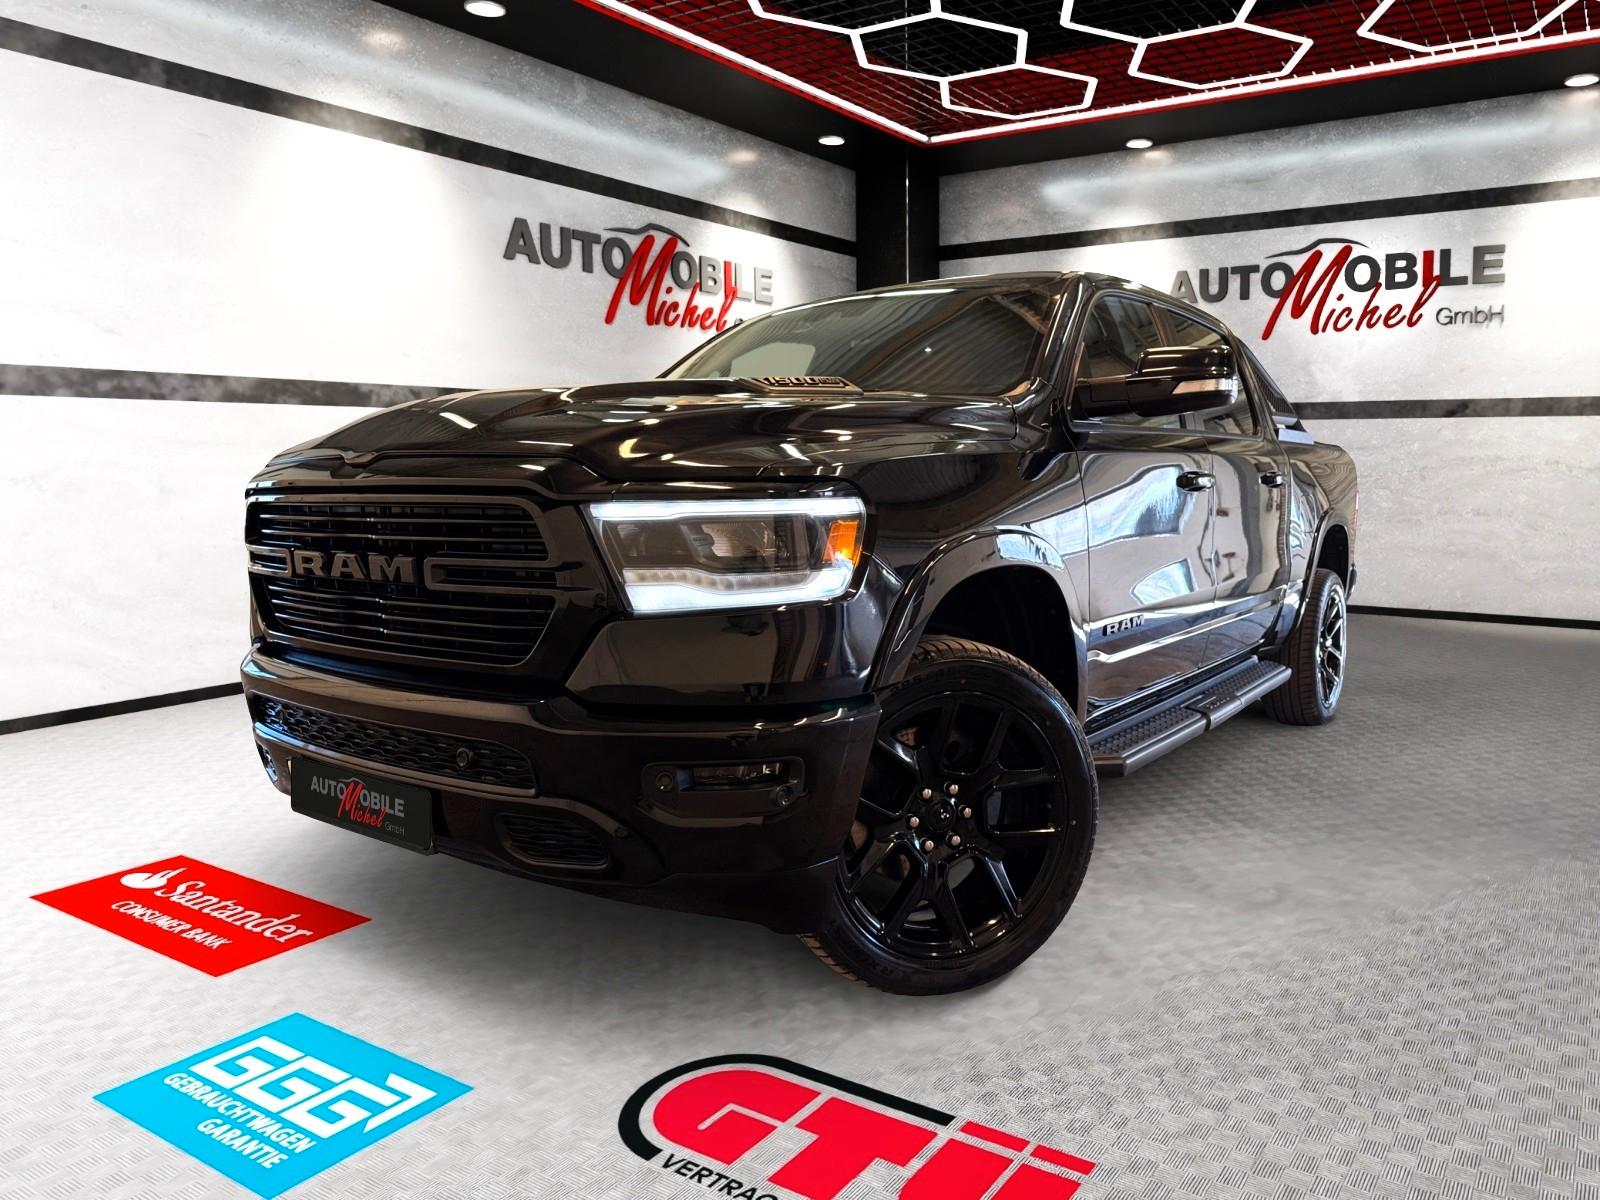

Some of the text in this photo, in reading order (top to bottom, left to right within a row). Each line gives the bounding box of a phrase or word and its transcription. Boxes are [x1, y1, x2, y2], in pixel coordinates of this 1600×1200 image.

[604, 234, 738, 333] Michel
[1261, 244, 1506, 341] Michel GmbH
[294, 549, 417, 584] RAM
[1102, 613, 1145, 636] RAM
[337, 781, 405, 837] Michel GmbH
[110, 900, 233, 950] CONSUMER BANK
[153, 880, 314, 944] Santander
[163, 1072, 317, 1154] GEBRAUCHTWAGEN
[188, 1035, 402, 1139] GGG
[196, 1117, 289, 1170] GARANTIE
